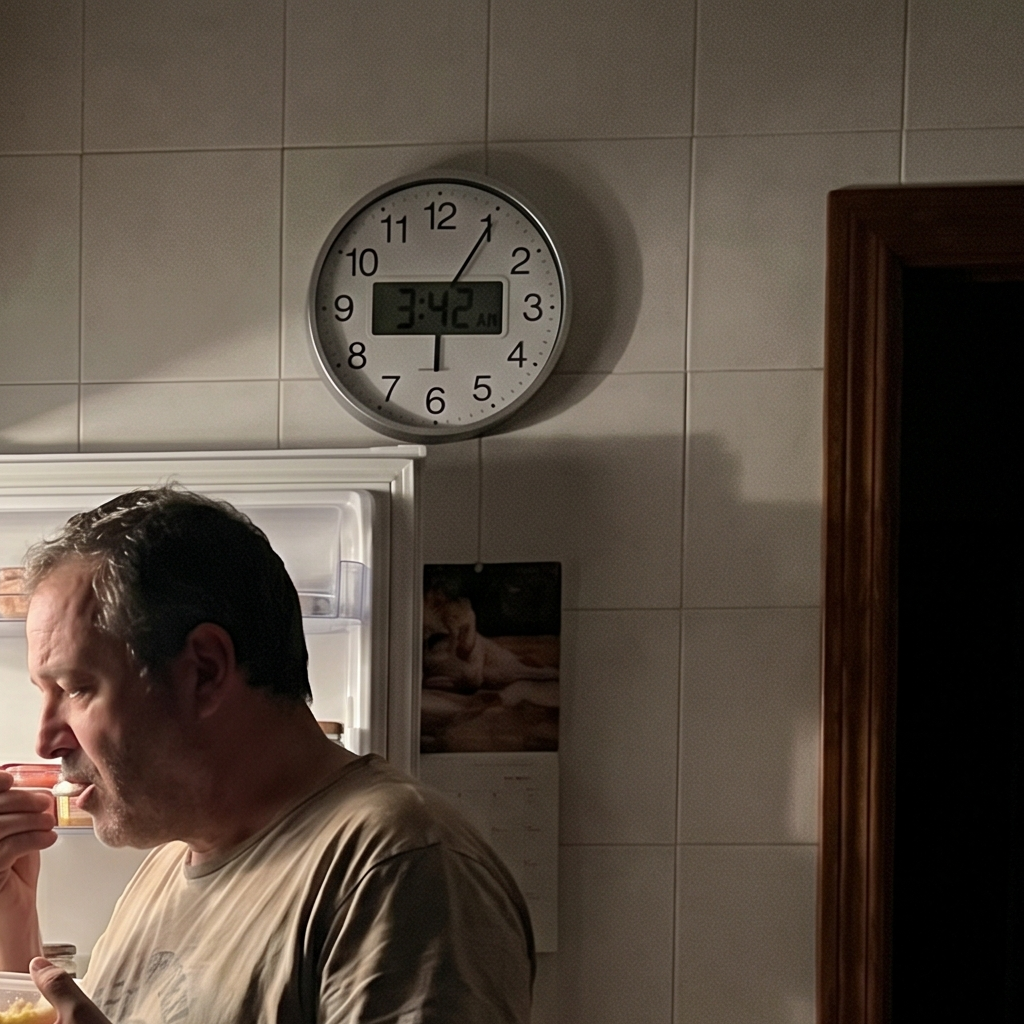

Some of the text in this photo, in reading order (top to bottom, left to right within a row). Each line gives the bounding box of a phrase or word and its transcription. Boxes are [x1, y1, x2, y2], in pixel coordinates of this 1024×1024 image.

[380, 214, 406, 243] 11
[424, 201, 457, 230] 12
[480, 213, 492, 242] 1
[346, 248, 379, 276] 10
[510, 247, 531, 275] 2
[334, 294, 354, 322] 9
[396, 287, 498, 329] 3:42 AM
[523, 293, 543, 322] 3
[348, 341, 367, 369] 8
[507, 340, 528, 368] 4
[381, 375, 401, 402] 7
[425, 387, 446, 414] 6
[472, 375, 492, 401] 5
